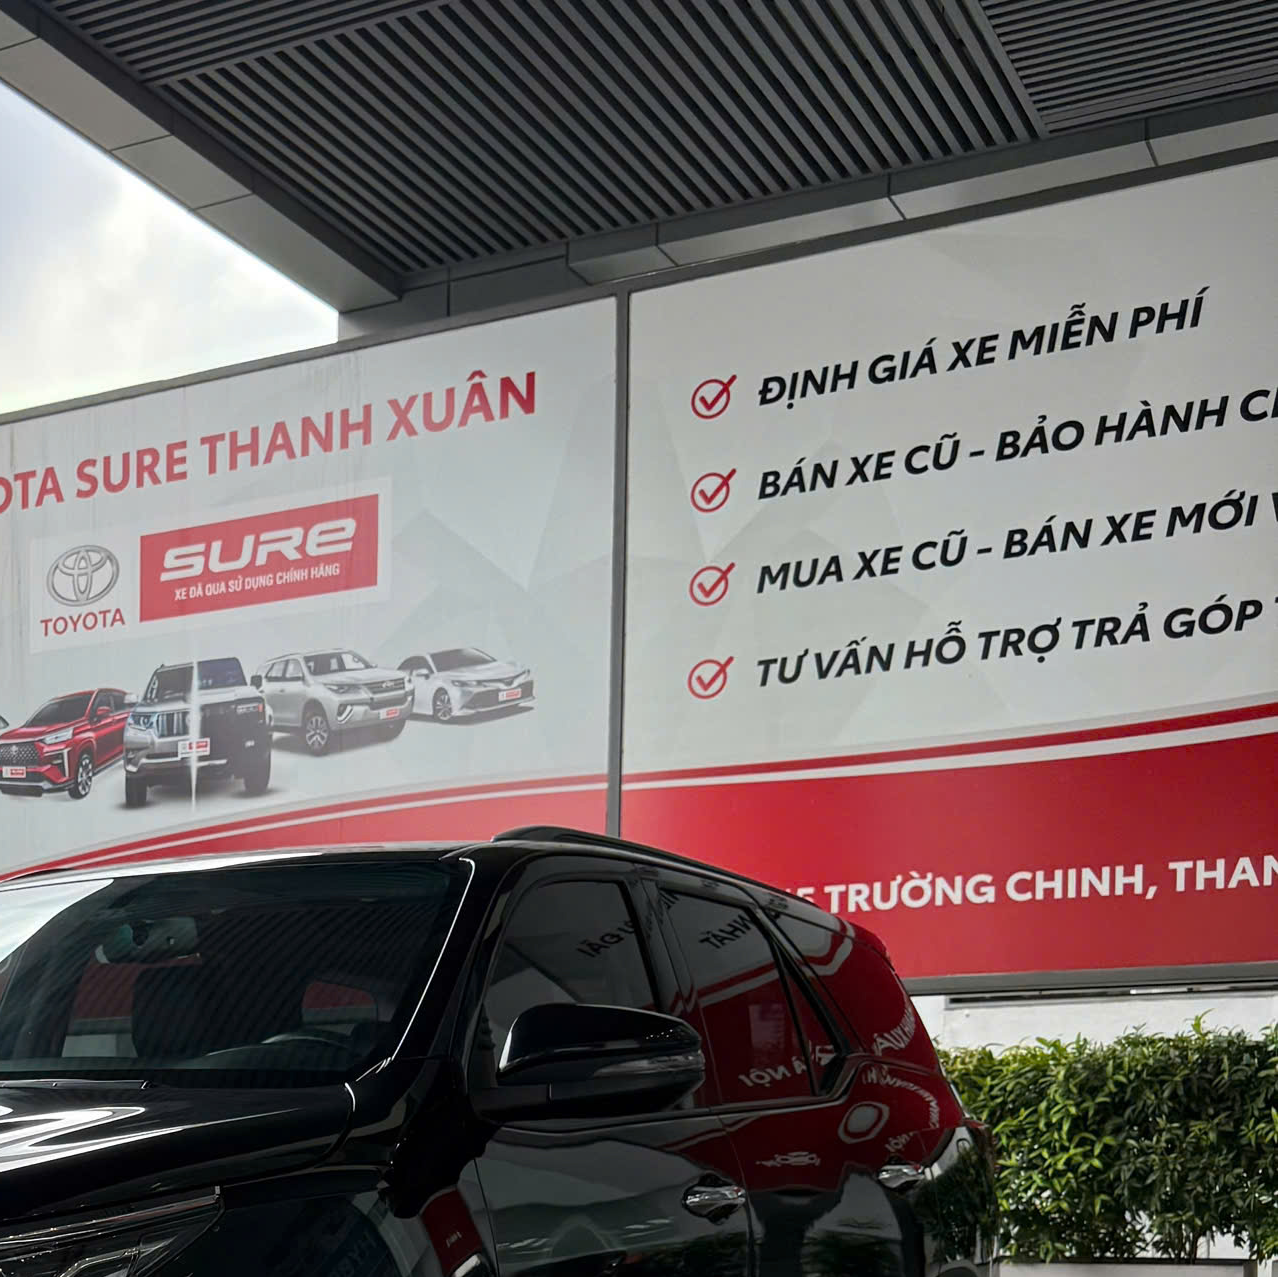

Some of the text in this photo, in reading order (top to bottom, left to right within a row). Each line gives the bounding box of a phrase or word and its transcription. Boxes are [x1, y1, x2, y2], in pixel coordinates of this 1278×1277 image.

[758, 285, 1210, 410] ĐỊNH GIÁ XE MIỄN PHÍ
[76, 439, 188, 499] SURE
[200, 403, 372, 476] THANH
[386, 370, 536, 441] XUÂN
[758, 457, 838, 500] BÁN
[845, 450, 896, 486] XE
[904, 431, 961, 475] CŨ
[995, 414, 1085, 462] BẢO
[1094, 395, 1230, 446] HÀNH
[1240, 387, 1278, 422] C
[174, 587, 187, 601] XE
[205, 582, 226, 597] QUA
[244, 573, 274, 592] DỤNG
[276, 568, 308, 585] CHÍNH
[756, 555, 844, 594] MUA
[852, 545, 903, 580] XE
[911, 528, 968, 571] CŨ
[1003, 515, 1093, 559] BÁN
[1100, 509, 1157, 547] XE
[1165, 489, 1259, 537] MỚI
[40, 607, 126, 638] TOYOTA
[757, 593, 1263, 687] TƯ VẤN HỖ TRỢ TRẢ GÓP
[824, 870, 995, 914] TRƯỜNG
[1005, 863, 1158, 902] CHINH,
